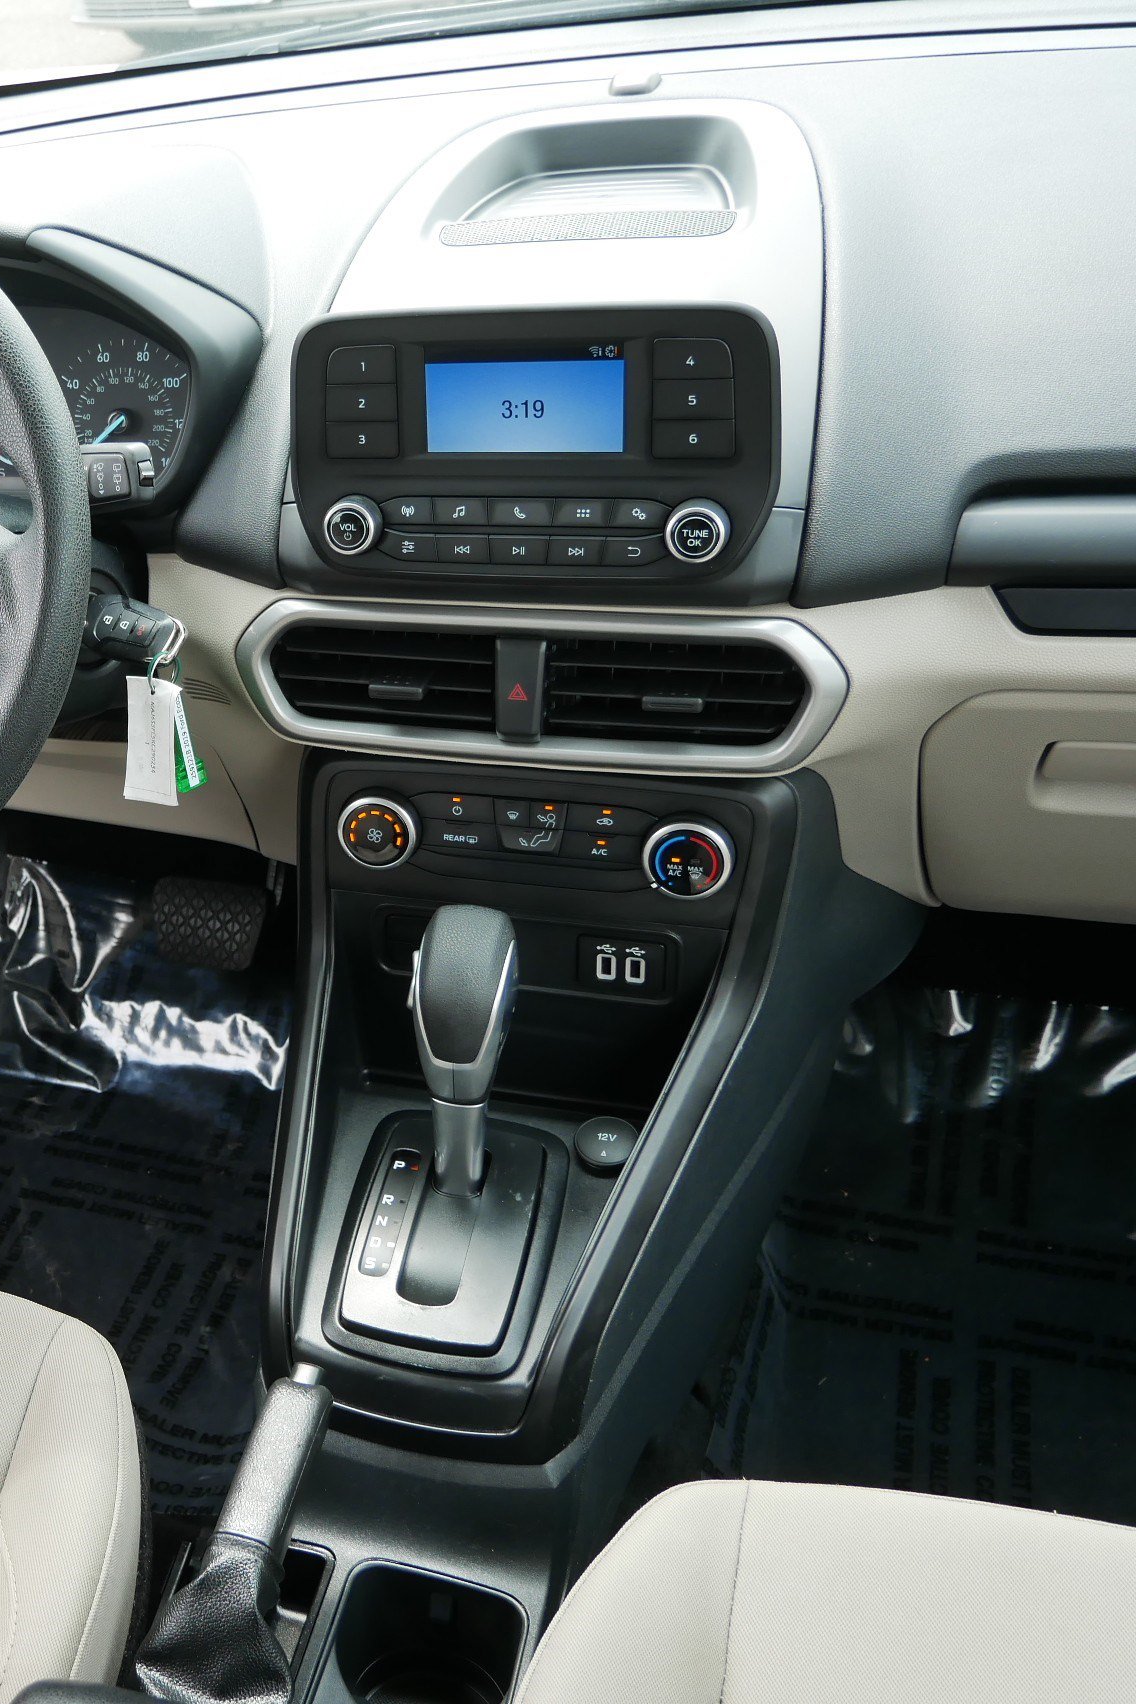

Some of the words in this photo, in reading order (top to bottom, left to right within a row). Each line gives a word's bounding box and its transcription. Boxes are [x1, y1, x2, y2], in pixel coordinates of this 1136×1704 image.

[97, 352, 110, 363] 60
[136, 351, 150, 362] 80
[686, 356, 695, 366] 4
[360, 361, 366, 372] 1
[66, 379, 79, 389] 40
[138, 382, 149, 390] 140
[162, 377, 180, 388] 100
[358, 399, 366, 409] 2
[688, 395, 696, 405] 5
[500, 399, 545, 419] 3:19
[358, 435, 366, 445] 3
[689, 434, 697, 444] 6
[339, 523, 357, 532] VOL
[682, 529, 709, 538] TUNE
[687, 538, 702, 547] OK
[443, 834, 465, 843] REAR
[591, 848, 607, 856] A/C
[668, 869, 682, 877] A/C
[597, 1132, 617, 1142] 12V
[392, 1160, 405, 1170] P
[381, 1194, 394, 1205] R
[375, 1215, 389, 1226] N
[369, 1237, 382, 1248] D
[364, 1257, 376, 1269] S
